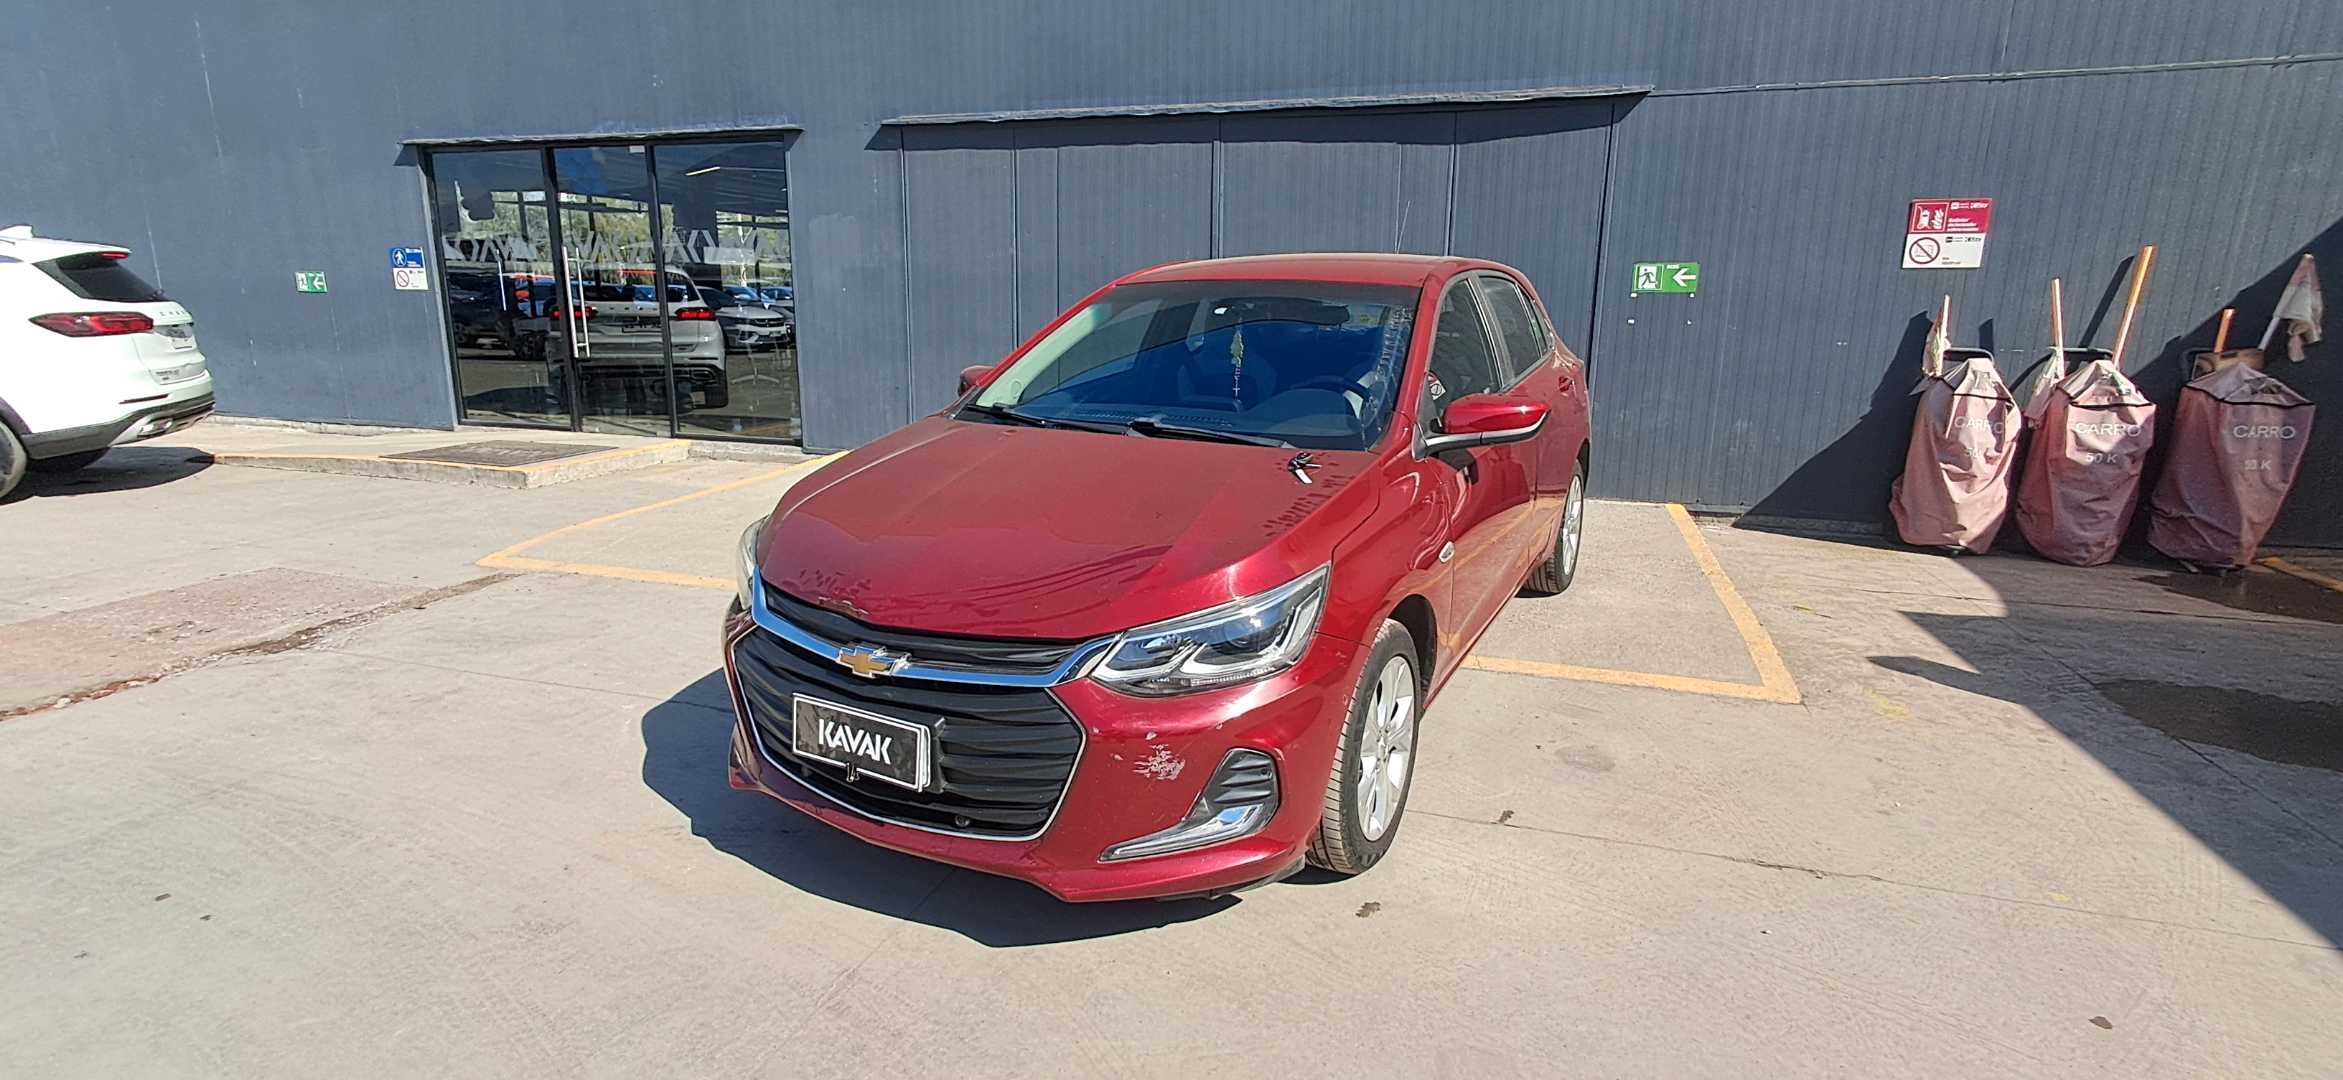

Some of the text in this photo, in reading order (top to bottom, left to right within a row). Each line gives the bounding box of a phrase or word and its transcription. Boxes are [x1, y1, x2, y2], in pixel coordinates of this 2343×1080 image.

[2075, 423, 2142, 437] CARRO
[2233, 425, 2296, 439] CARRO
[2087, 453, 2118, 464] 50 K
[2260, 459, 2272, 471] K
[818, 718, 893, 765] KAVAK
